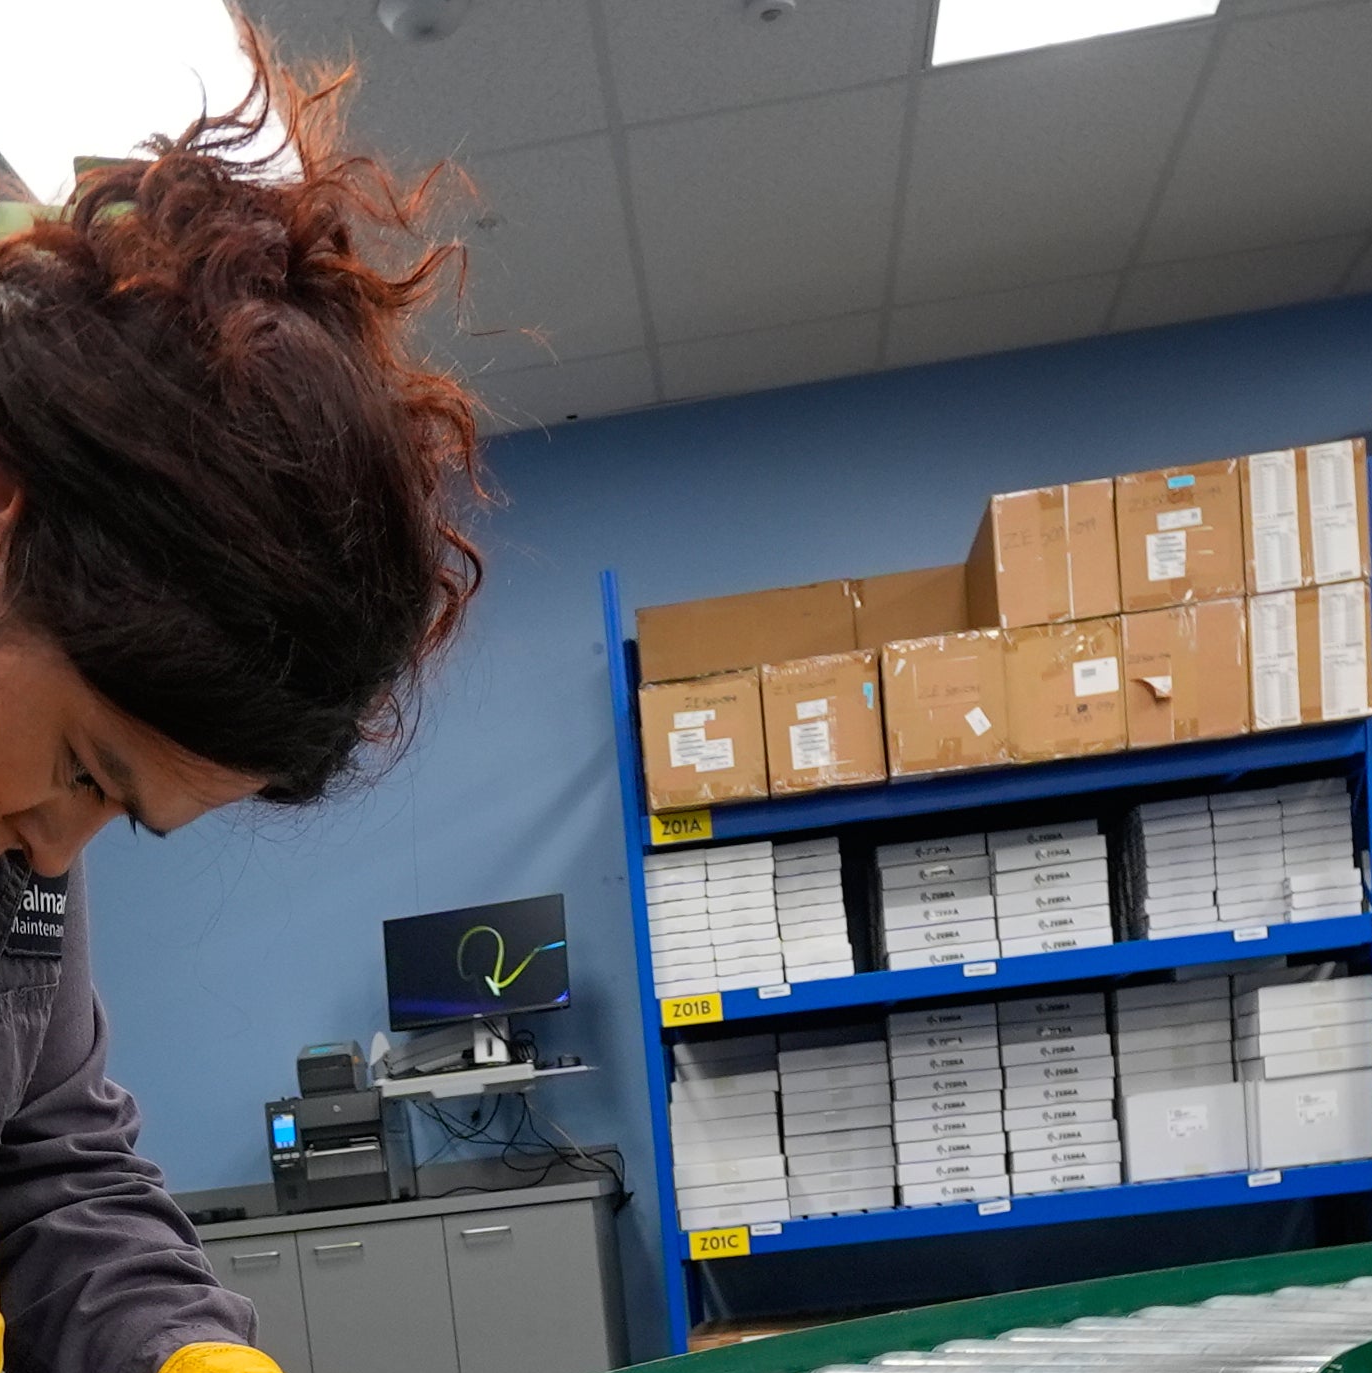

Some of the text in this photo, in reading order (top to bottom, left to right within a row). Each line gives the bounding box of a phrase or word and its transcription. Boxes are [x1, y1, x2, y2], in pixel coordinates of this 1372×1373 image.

[661, 817, 702, 836] Z01A
[673, 1000, 711, 1018] Z01B
[700, 1234, 739, 1251] Z01C
